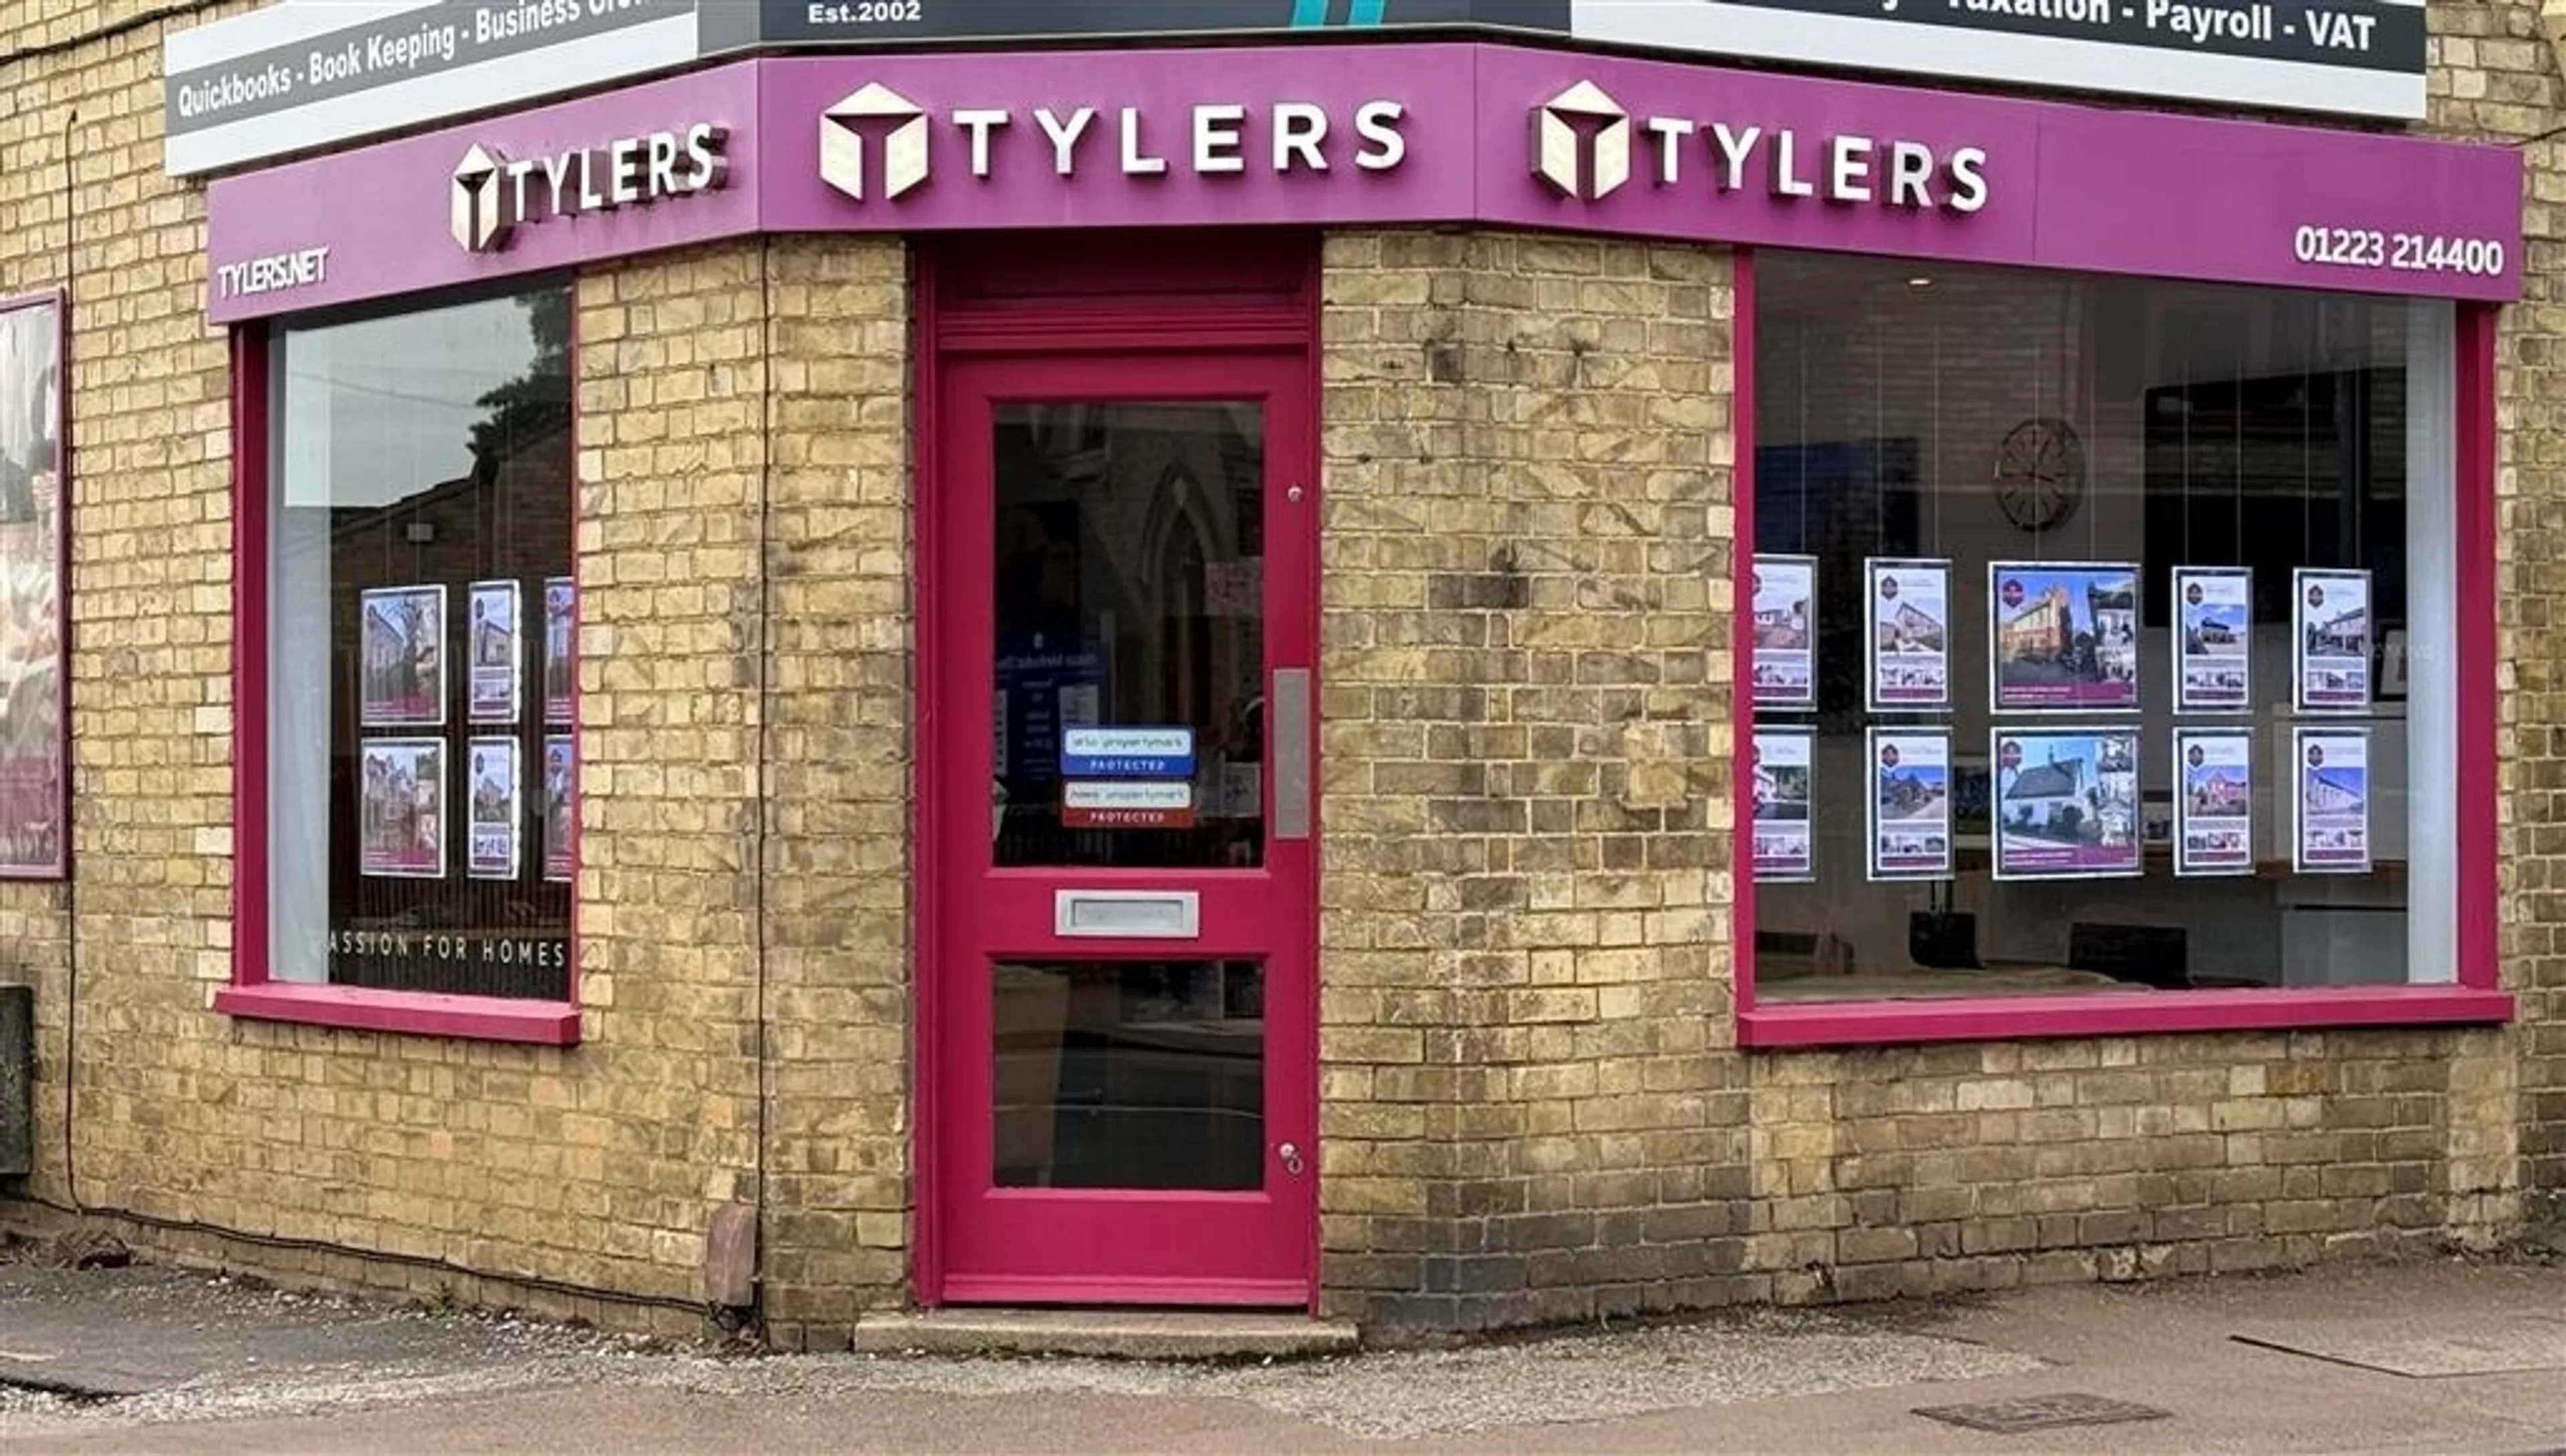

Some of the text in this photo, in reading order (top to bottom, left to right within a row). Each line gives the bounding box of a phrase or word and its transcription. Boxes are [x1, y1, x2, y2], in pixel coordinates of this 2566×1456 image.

[808, 0, 921, 23] Est.2002
[1949, 0, 2110, 24] xation
[2146, 0, 2272, 42] Payroll
[2304, 10, 2376, 51] VAT
[178, 64, 292, 117] Quickbooks
[309, 43, 362, 85] Book
[367, 23, 455, 71] Keeping
[475, 1, 580, 44] Business
[952, 100, 1407, 176] TYLERS
[507, 123, 714, 222] TYLERS
[1648, 116, 1987, 212] TYLERS
[2295, 225, 2504, 275] 01223 214400
[1089, 759, 1165, 770] PROTECTED
[1089, 811, 1165, 823] PROTECTED
[325, 930, 565, 968] ASSION FOR HOMES
